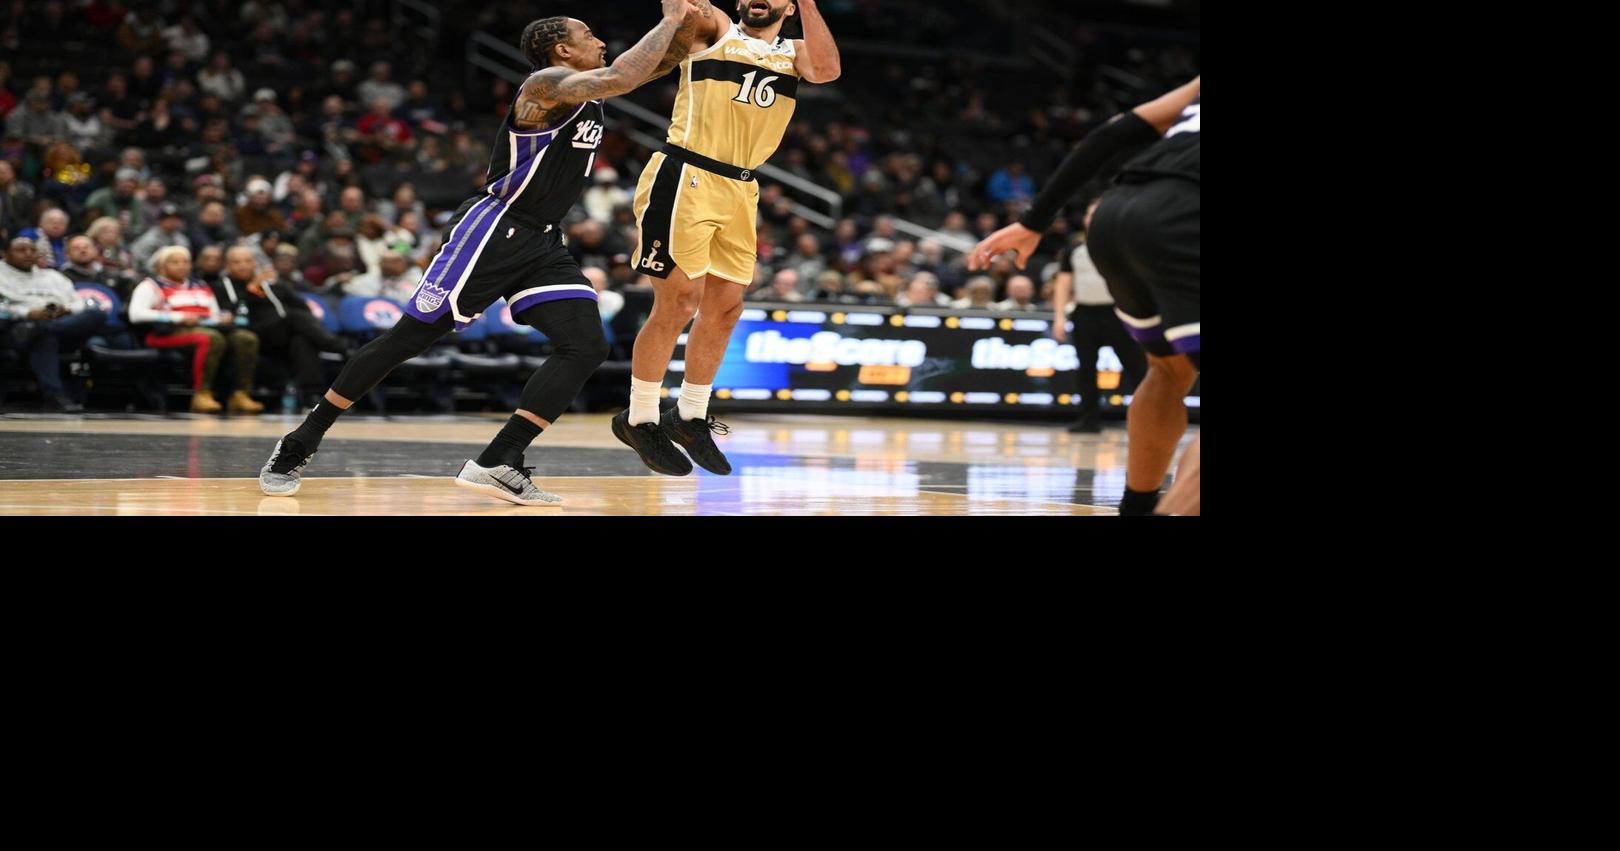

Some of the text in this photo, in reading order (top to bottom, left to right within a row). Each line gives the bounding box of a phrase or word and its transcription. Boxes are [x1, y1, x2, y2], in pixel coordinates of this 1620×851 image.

[731, 70, 779, 108] 16
[418, 292, 442, 307] KINGS
[745, 329, 927, 367] theScore
